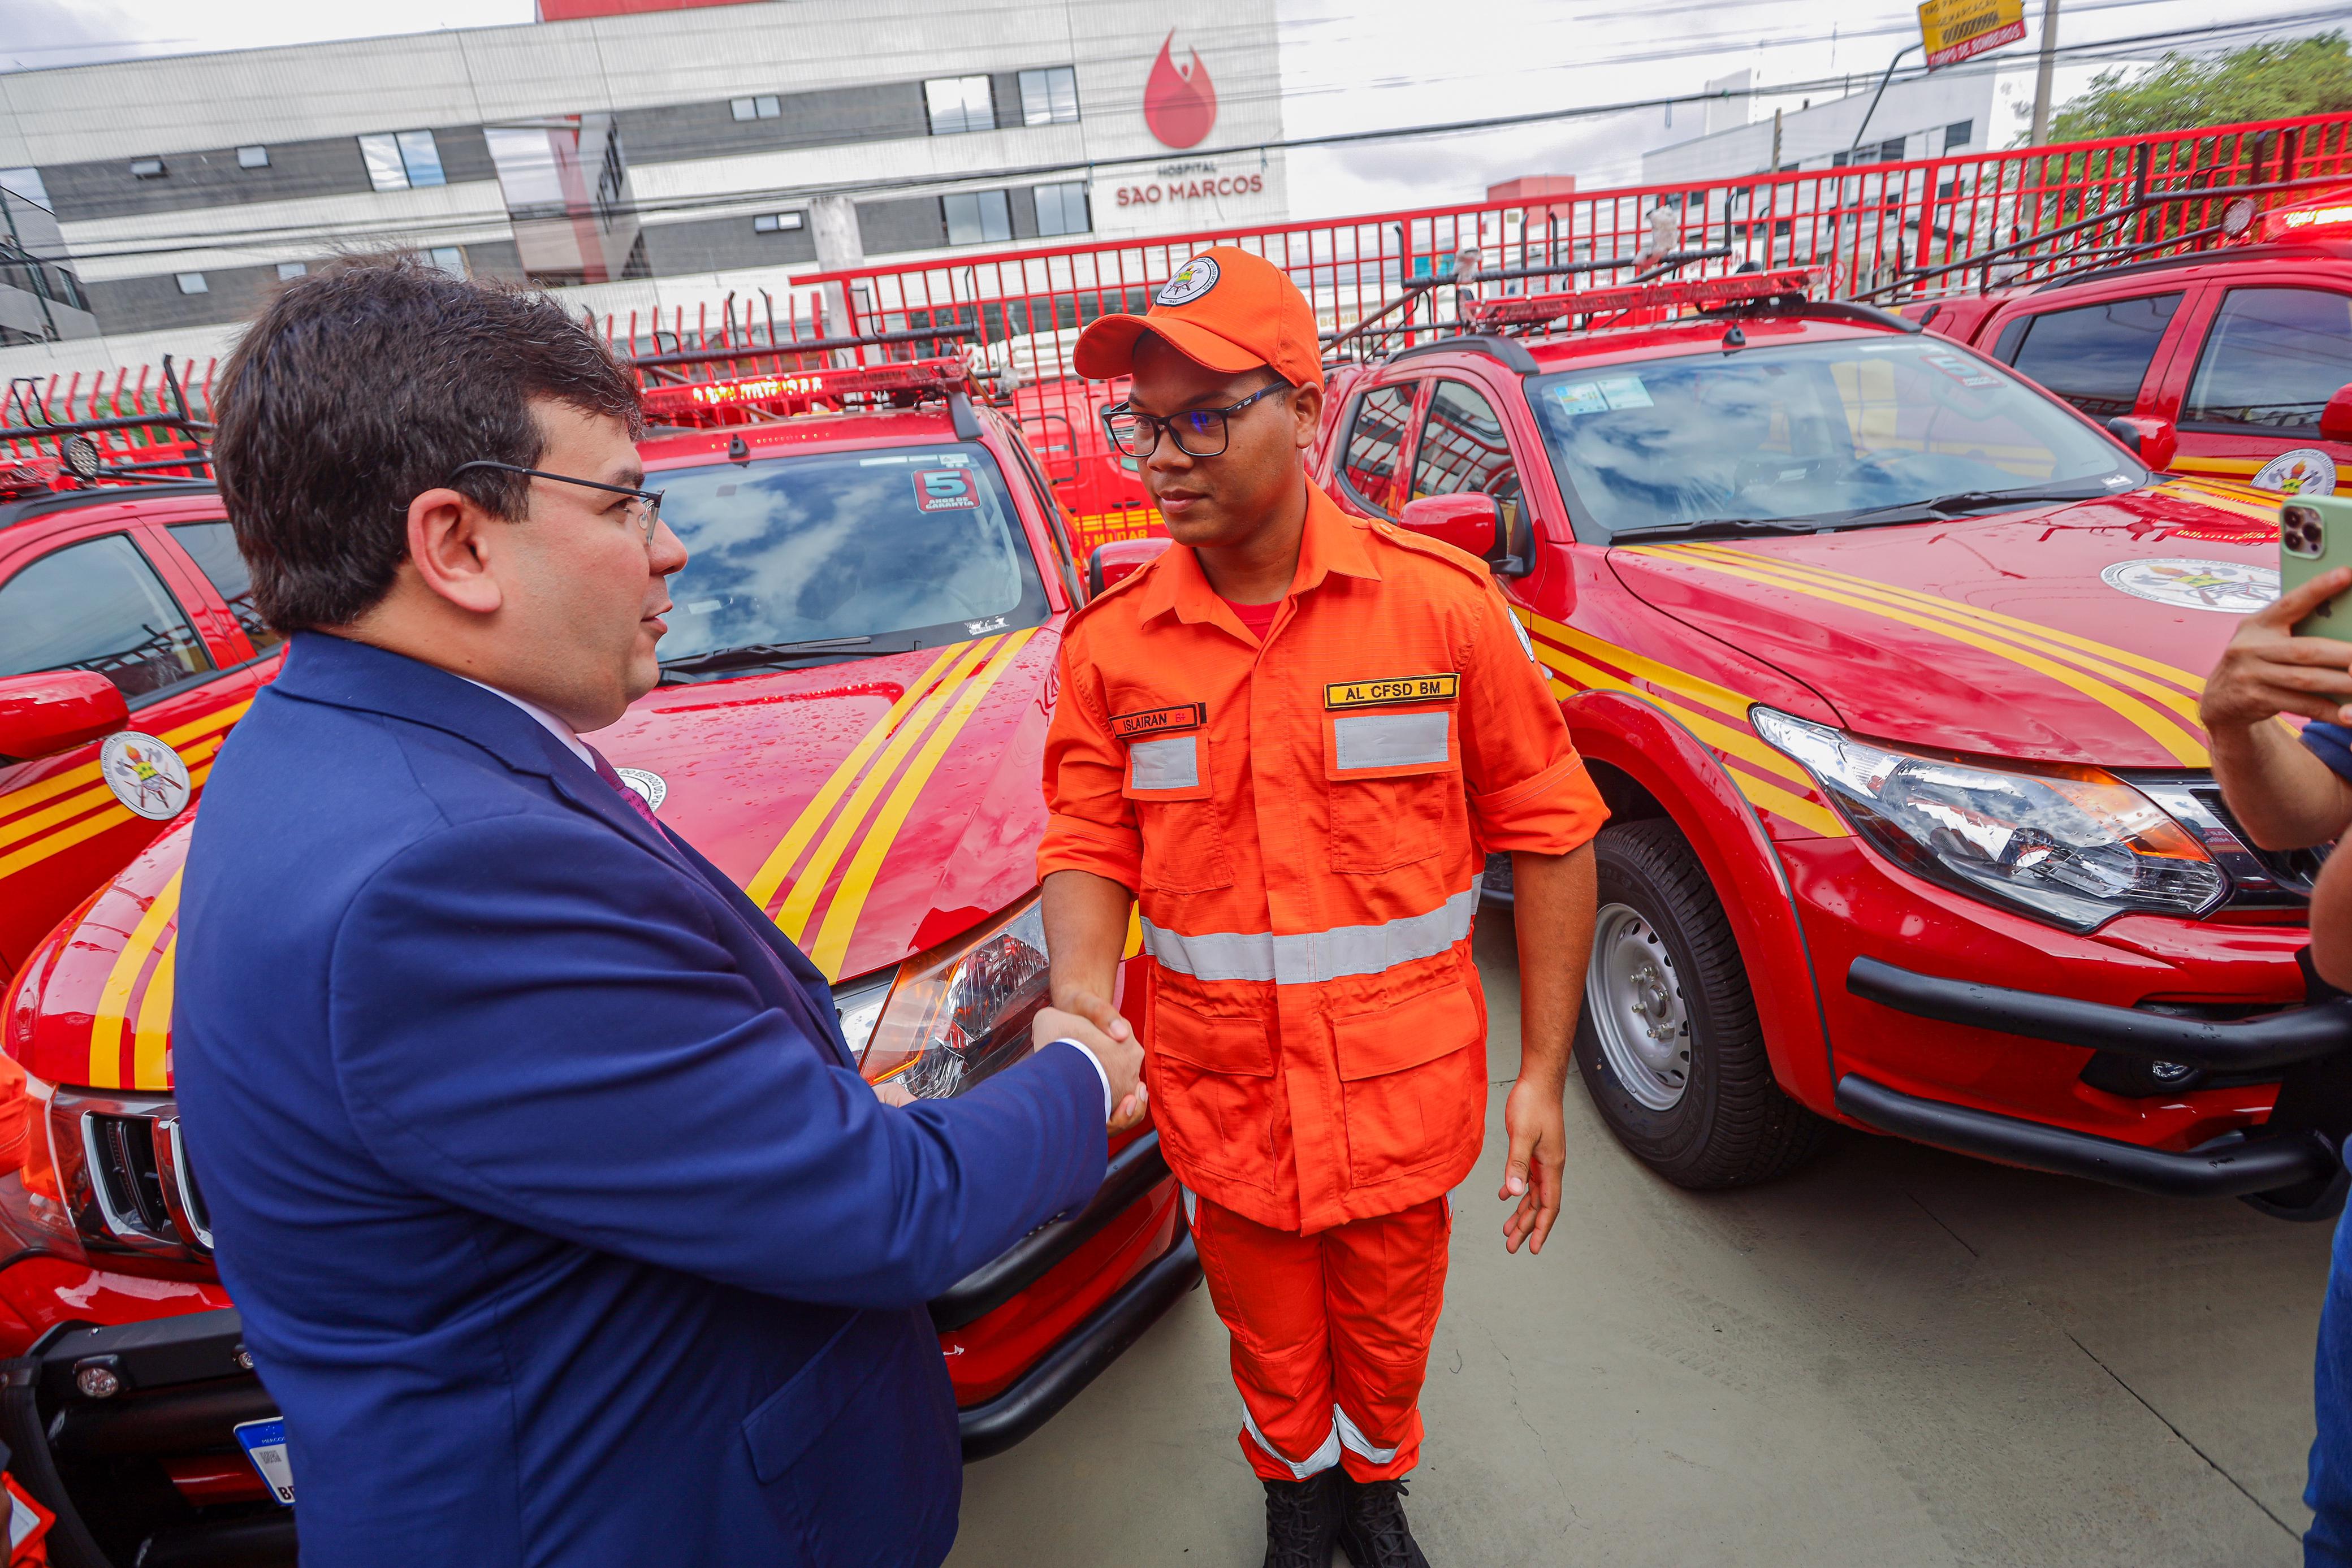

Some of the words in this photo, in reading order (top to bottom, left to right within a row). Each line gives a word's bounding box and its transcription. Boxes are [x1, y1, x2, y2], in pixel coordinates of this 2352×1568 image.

[1158, 162, 1216, 177] HOSPITAL
[1168, 173, 1264, 201] MARCOS
[923, 470, 968, 498] 5
[926, 501, 974, 509] GARANTIA
[1346, 687, 1365, 701] AL
[1371, 683, 1413, 699] CFSD
[1420, 681, 1441, 695] BM
[1123, 713, 1168, 732] ISLAIRAN
[634, 772, 661, 786] ESTADO
[654, 786, 663, 794] DO
